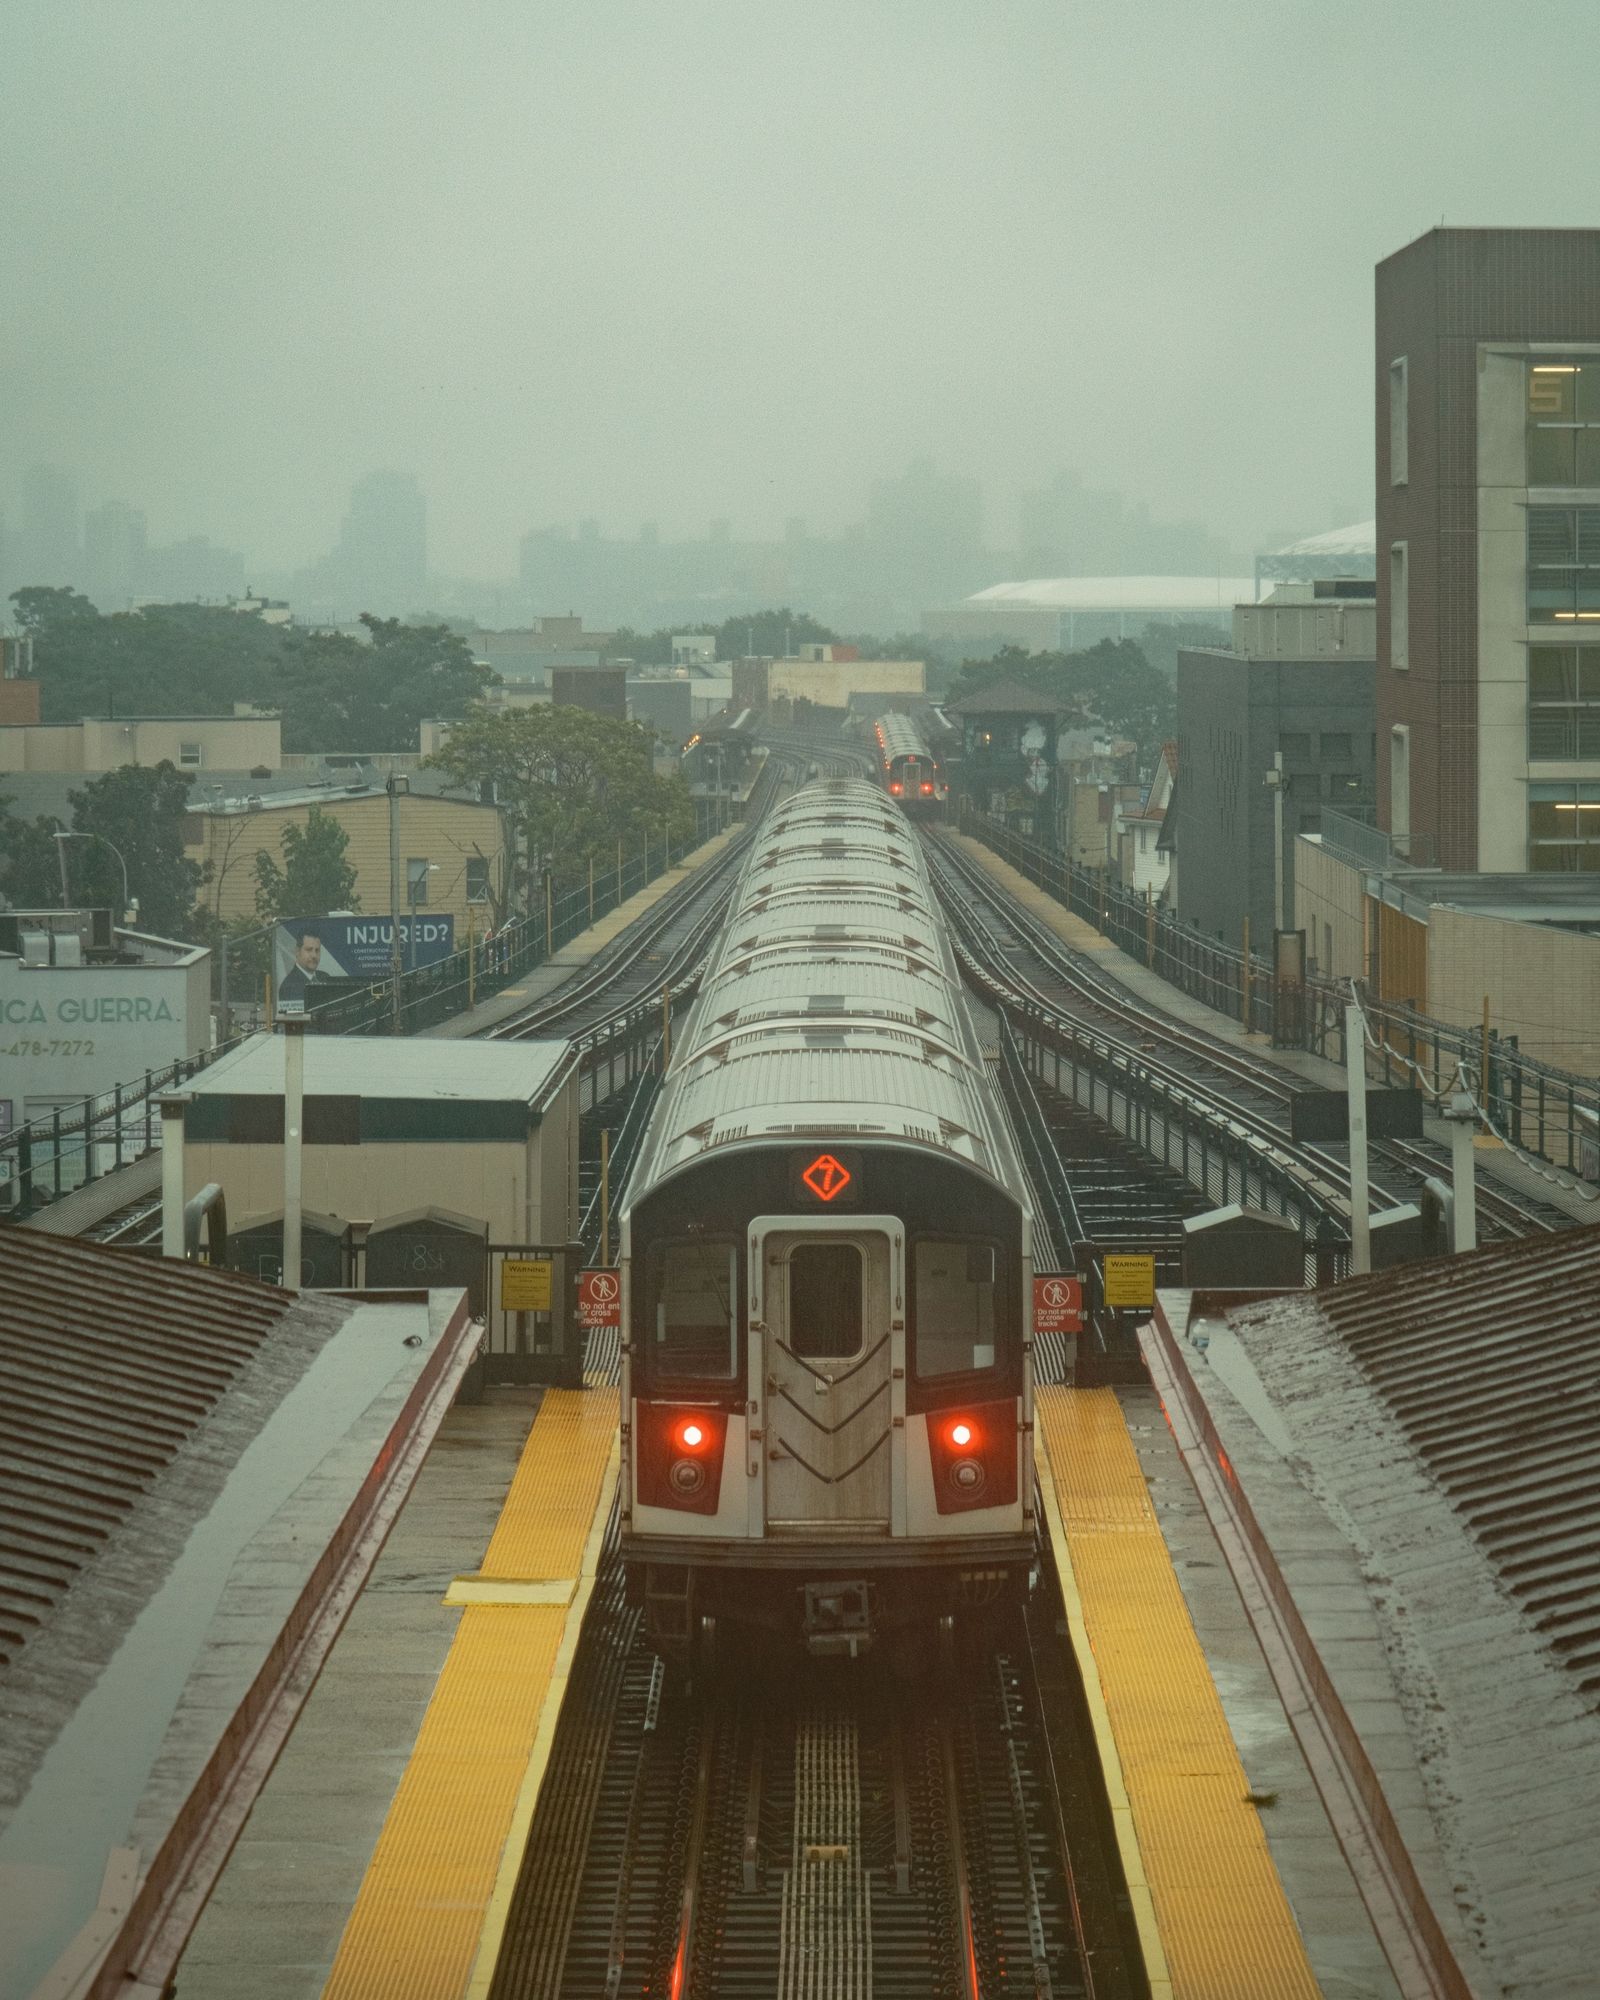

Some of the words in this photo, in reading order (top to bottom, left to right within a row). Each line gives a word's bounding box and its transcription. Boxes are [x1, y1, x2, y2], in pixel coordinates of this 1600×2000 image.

[346, 924, 448, 944] INJURED?
[818, 1162, 835, 1191] 7
[509, 1265, 546, 1273] WARNING
[580, 1302, 591, 1310] Do
[593, 1302, 605, 1310] not
[608, 1302, 620, 1310] ent
